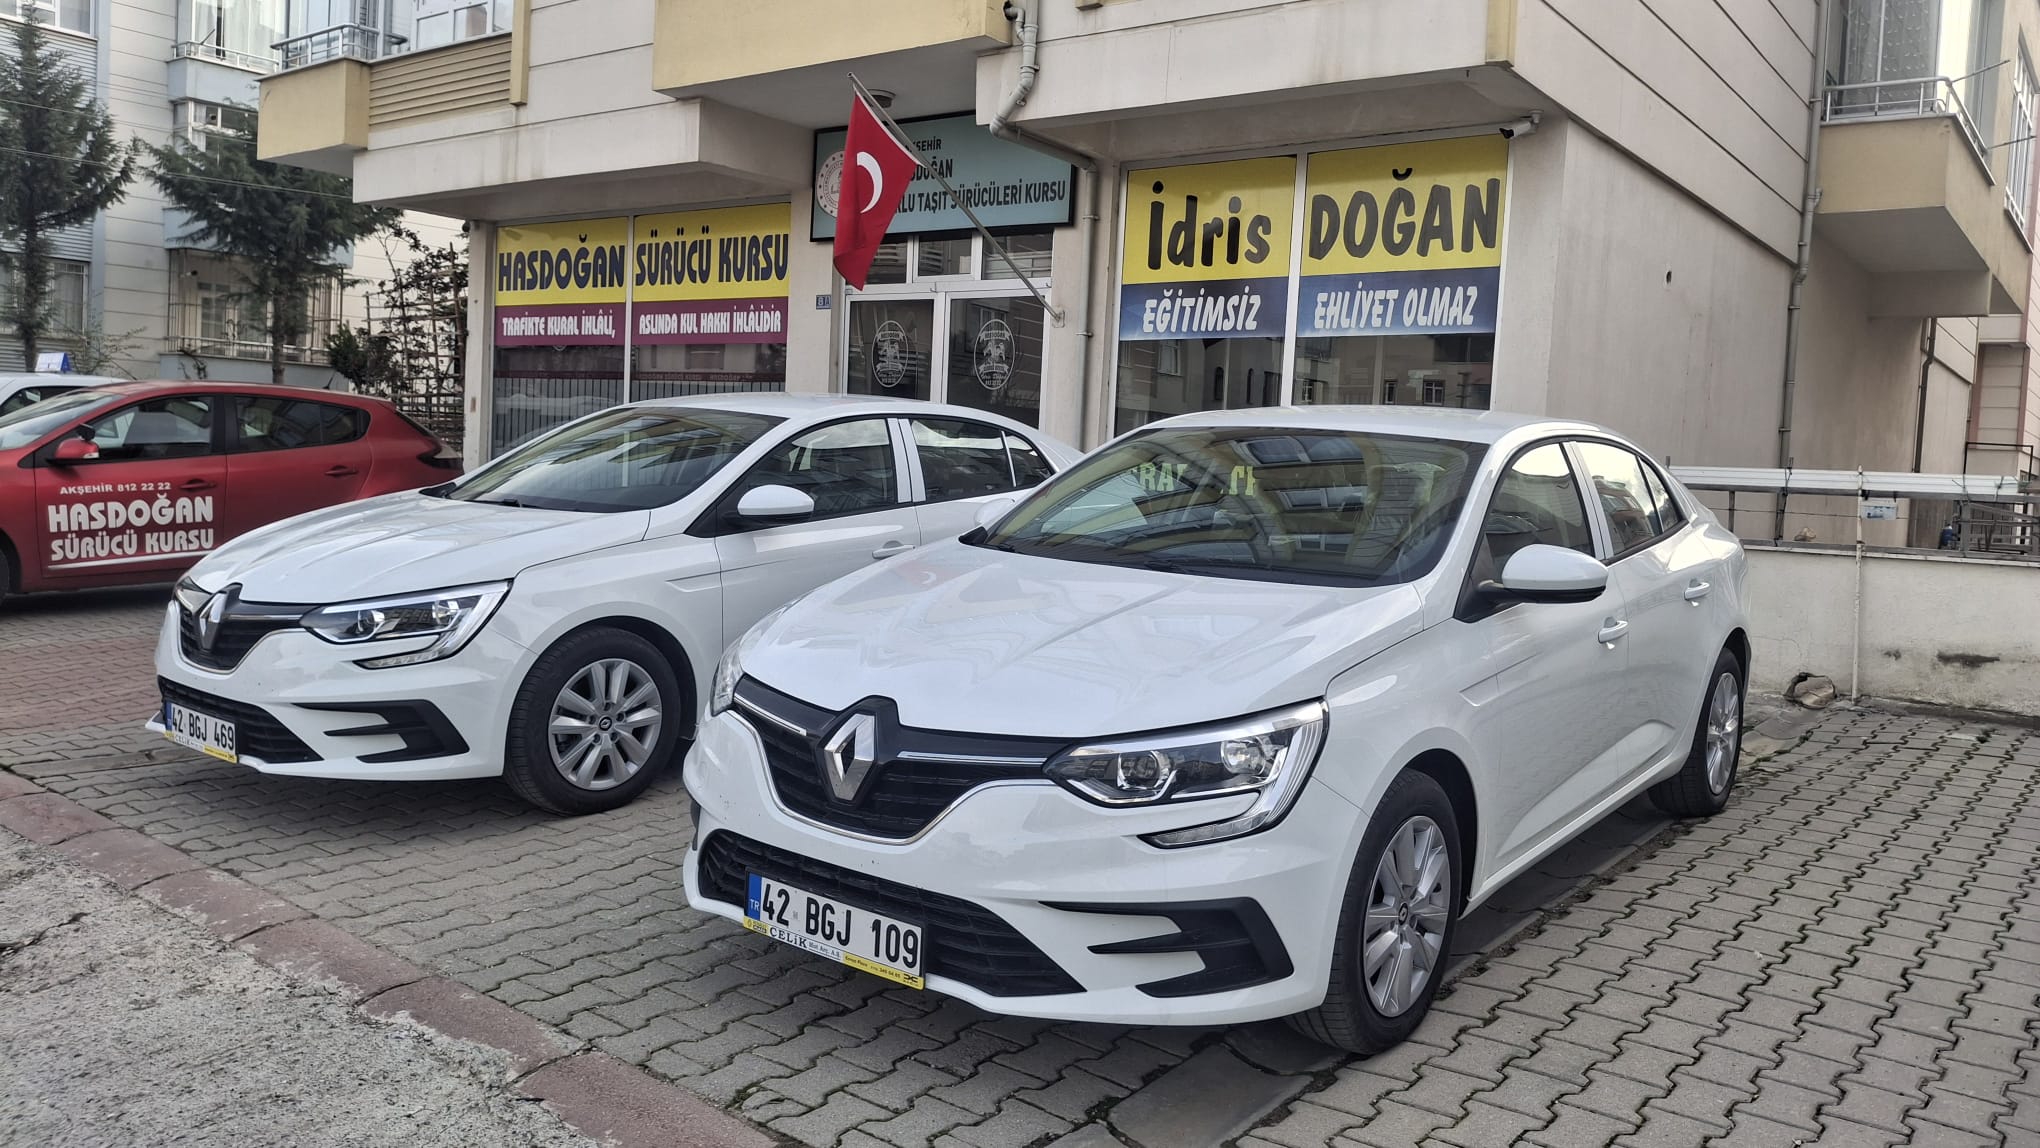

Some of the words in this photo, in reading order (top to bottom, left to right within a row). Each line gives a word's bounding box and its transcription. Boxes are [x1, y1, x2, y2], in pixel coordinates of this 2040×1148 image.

[918, 192, 948, 214] TAŞIT
[1025, 180, 1066, 204] KURSU
[1147, 180, 1272, 271] İdris
[1308, 167, 1501, 261] DOĞAN
[498, 233, 625, 292] HASDOĞAN
[635, 225, 712, 287] SÜRÜCÜ
[718, 232, 789, 283] KURSU
[502, 310, 546, 337] TRAFİKTE
[546, 316, 580, 336] KURAL
[639, 315, 678, 335] ASLINDA
[679, 313, 699, 334] KUL
[700, 312, 731, 334] HAKKI
[1142, 285, 1262, 333] EĞİTİMSİZ
[1313, 280, 1399, 330] EHLİYET
[1402, 285, 1478, 328] OLMAZ
[59, 482, 113, 496] AKŞEHİR
[117, 482, 137, 492] 812
[140, 482, 155, 491] 22
[157, 482, 171, 491] 22
[48, 493, 213, 532] HASDOĞAN
[50, 529, 138, 561] SÜRÜCÜ
[145, 528, 214, 553] KURSU
[172, 707, 184, 733] 42
[188, 712, 207, 742] BGJ
[214, 722, 235, 751] 469
[749, 898, 760, 911] TR
[762, 884, 790, 927] 42
[805, 896, 852, 947] BGJ
[872, 918, 920, 969] 109
